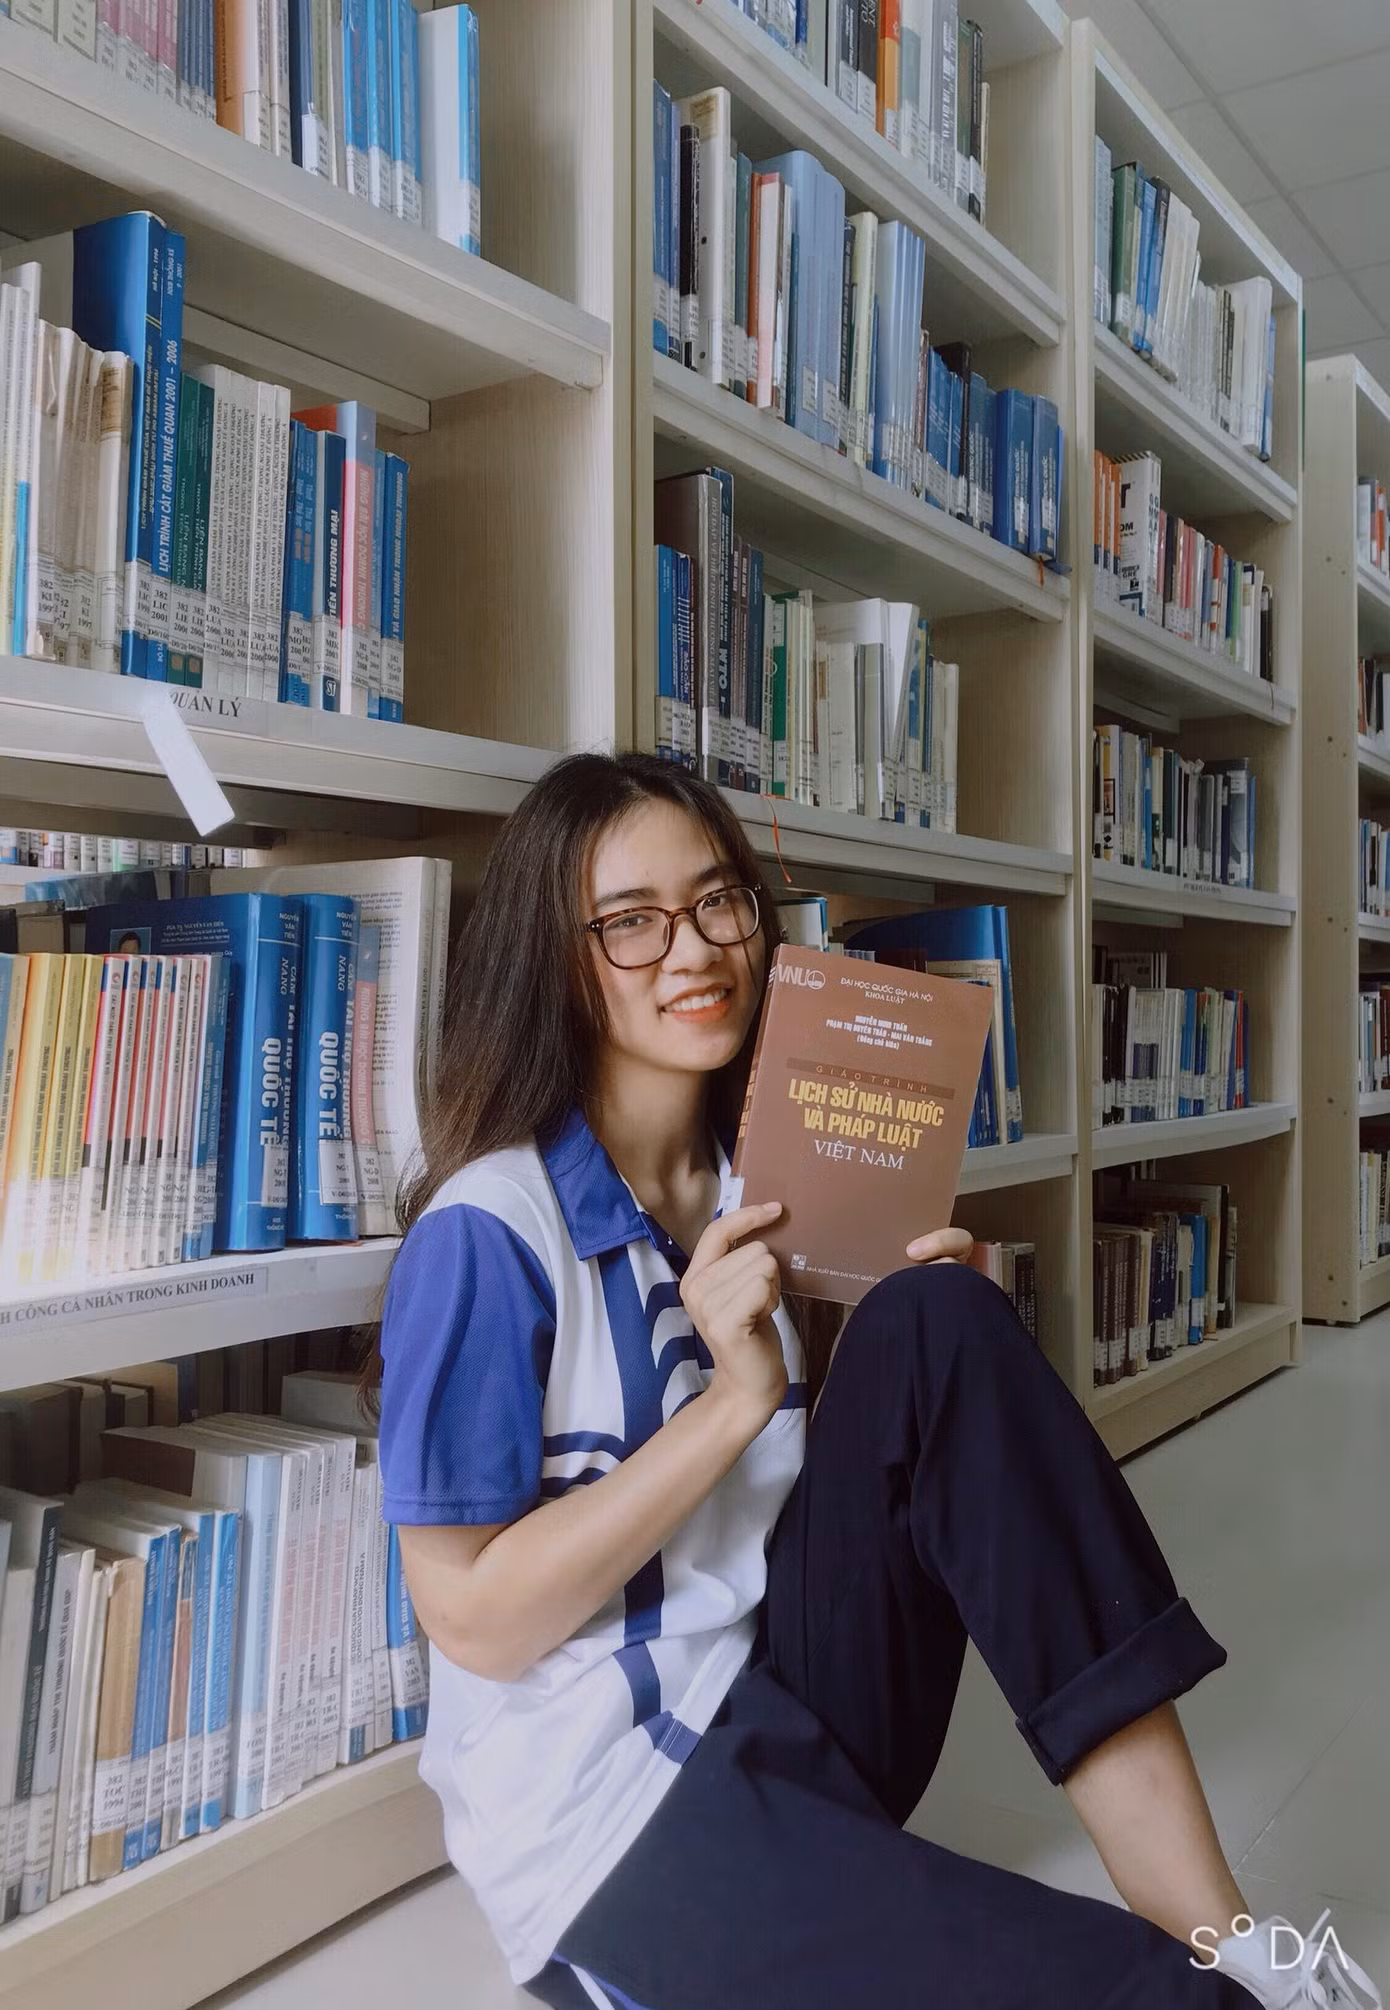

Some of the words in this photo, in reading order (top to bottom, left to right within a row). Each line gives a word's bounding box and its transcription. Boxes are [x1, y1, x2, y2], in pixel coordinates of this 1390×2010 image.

[166, 339, 178, 365] 2006
[165, 377, 176, 402] 2001
[164, 403, 175, 435] QUAN
[157, 513, 171, 547] TRÌNH
[155, 589, 169, 600] 382
[176, 601, 189, 613] 382
[151, 611, 169, 623] 2001
[718, 648, 728, 690] WTO
[218, 696, 242, 718] LÝ
[840, 977, 853, 986] ĐẠI
[854, 979, 871, 989] HỌC
[871, 983, 894, 994] QUỐC
[894, 988, 908, 997] GIA
[864, 991, 885, 1001] KHOA
[886, 995, 906, 1005] LUẬT
[261, 1037, 284, 1108] QUỐC
[319, 1030, 343, 1101] QUỐC
[815, 1065, 862, 1081] GIÁO
[870, 1074, 928, 1094] TRÌNH
[788, 1078, 829, 1105] LỊCH
[829, 1081, 859, 1110] SỬ
[856, 1091, 894, 1118] NHÀ
[896, 1098, 946, 1127] NƯỚC
[319, 1107, 343, 1139] TẾ
[803, 1105, 824, 1132] VÀ
[827, 1112, 876, 1140] PHÁP
[876, 1122, 924, 1152] LUẬT
[813, 1139, 857, 1163] VIỆT
[859, 1148, 905, 1170] NAM
[15, 1303, 58, 1321] CÔNG
[61, 1300, 82, 1314] CÁ
[85, 1291, 124, 1310] NHÂN
[126, 1285, 174, 1303] TRONG
[176, 1279, 208, 1295] KINH
[211, 1273, 255, 1289] DOANH
